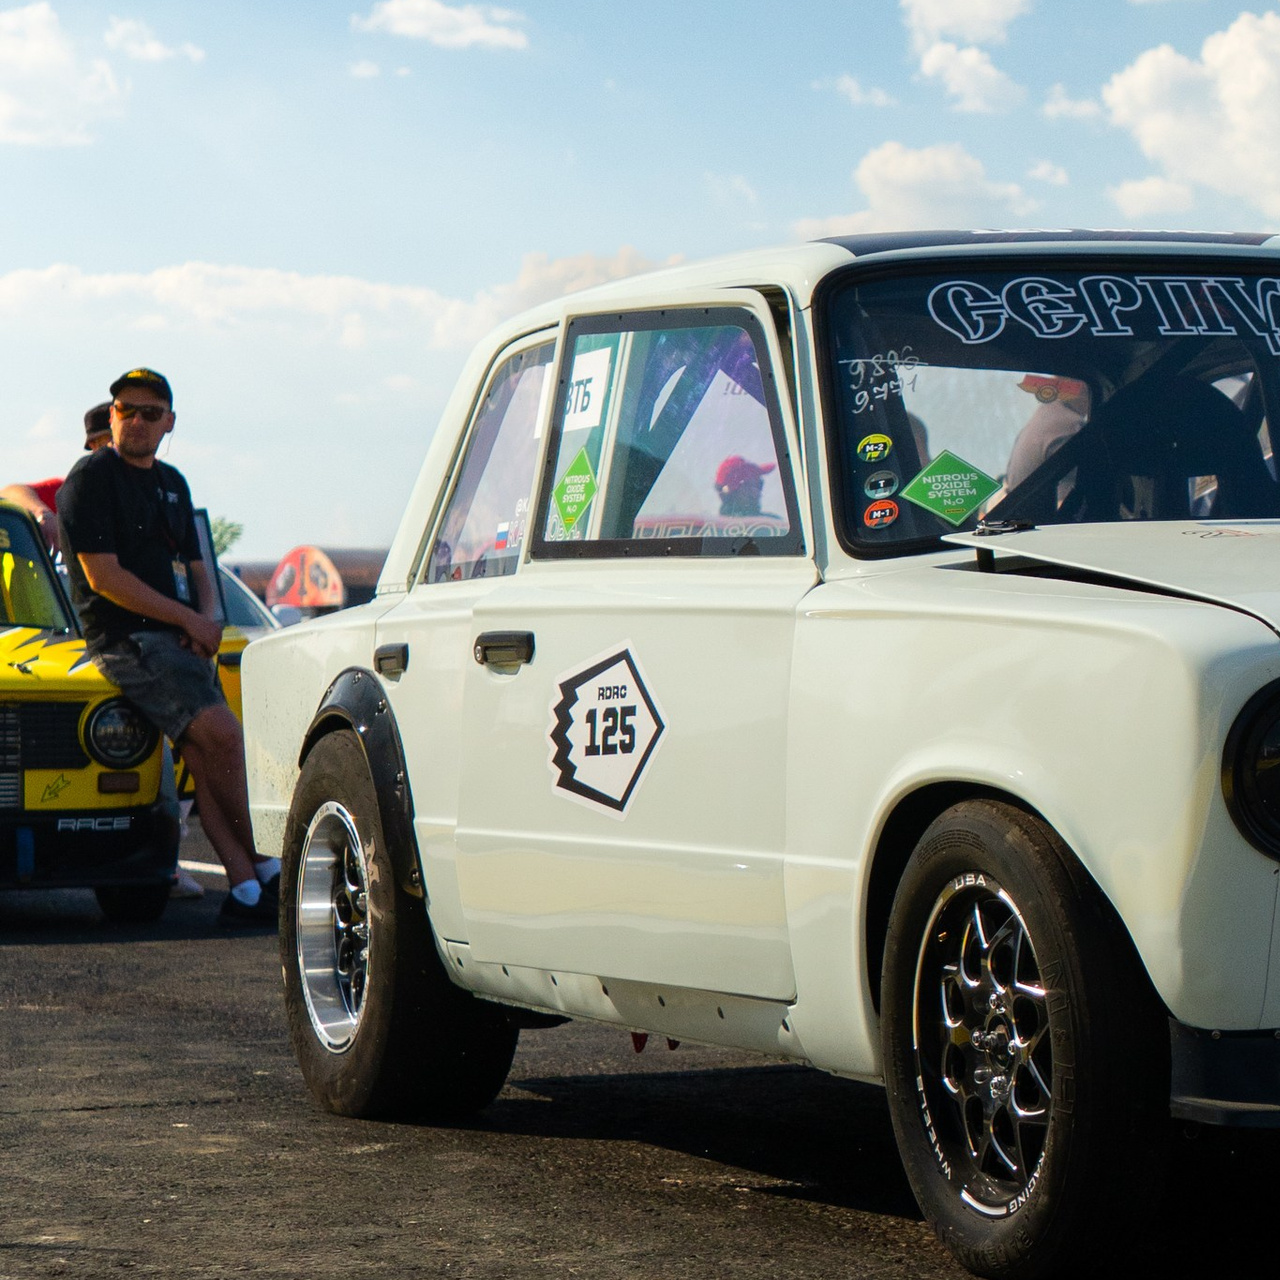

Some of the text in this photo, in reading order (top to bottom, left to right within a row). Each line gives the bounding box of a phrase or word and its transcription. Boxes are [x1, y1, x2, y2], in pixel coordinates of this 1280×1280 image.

[563, 473, 591, 485] NITROUS
[922, 472, 979, 485] NITROUS
[931, 480, 972, 490] OXIDE
[566, 483, 586, 493] OXIDE
[927, 488, 978, 499] SYSTEM
[562, 493, 586, 504] SYSTEM
[597, 685, 628, 701] RDRC
[584, 704, 637, 757] 125
[57, 816, 131, 832] RACE
[954, 872, 988, 890] USA
[1008, 1150, 1047, 1214] RACING
